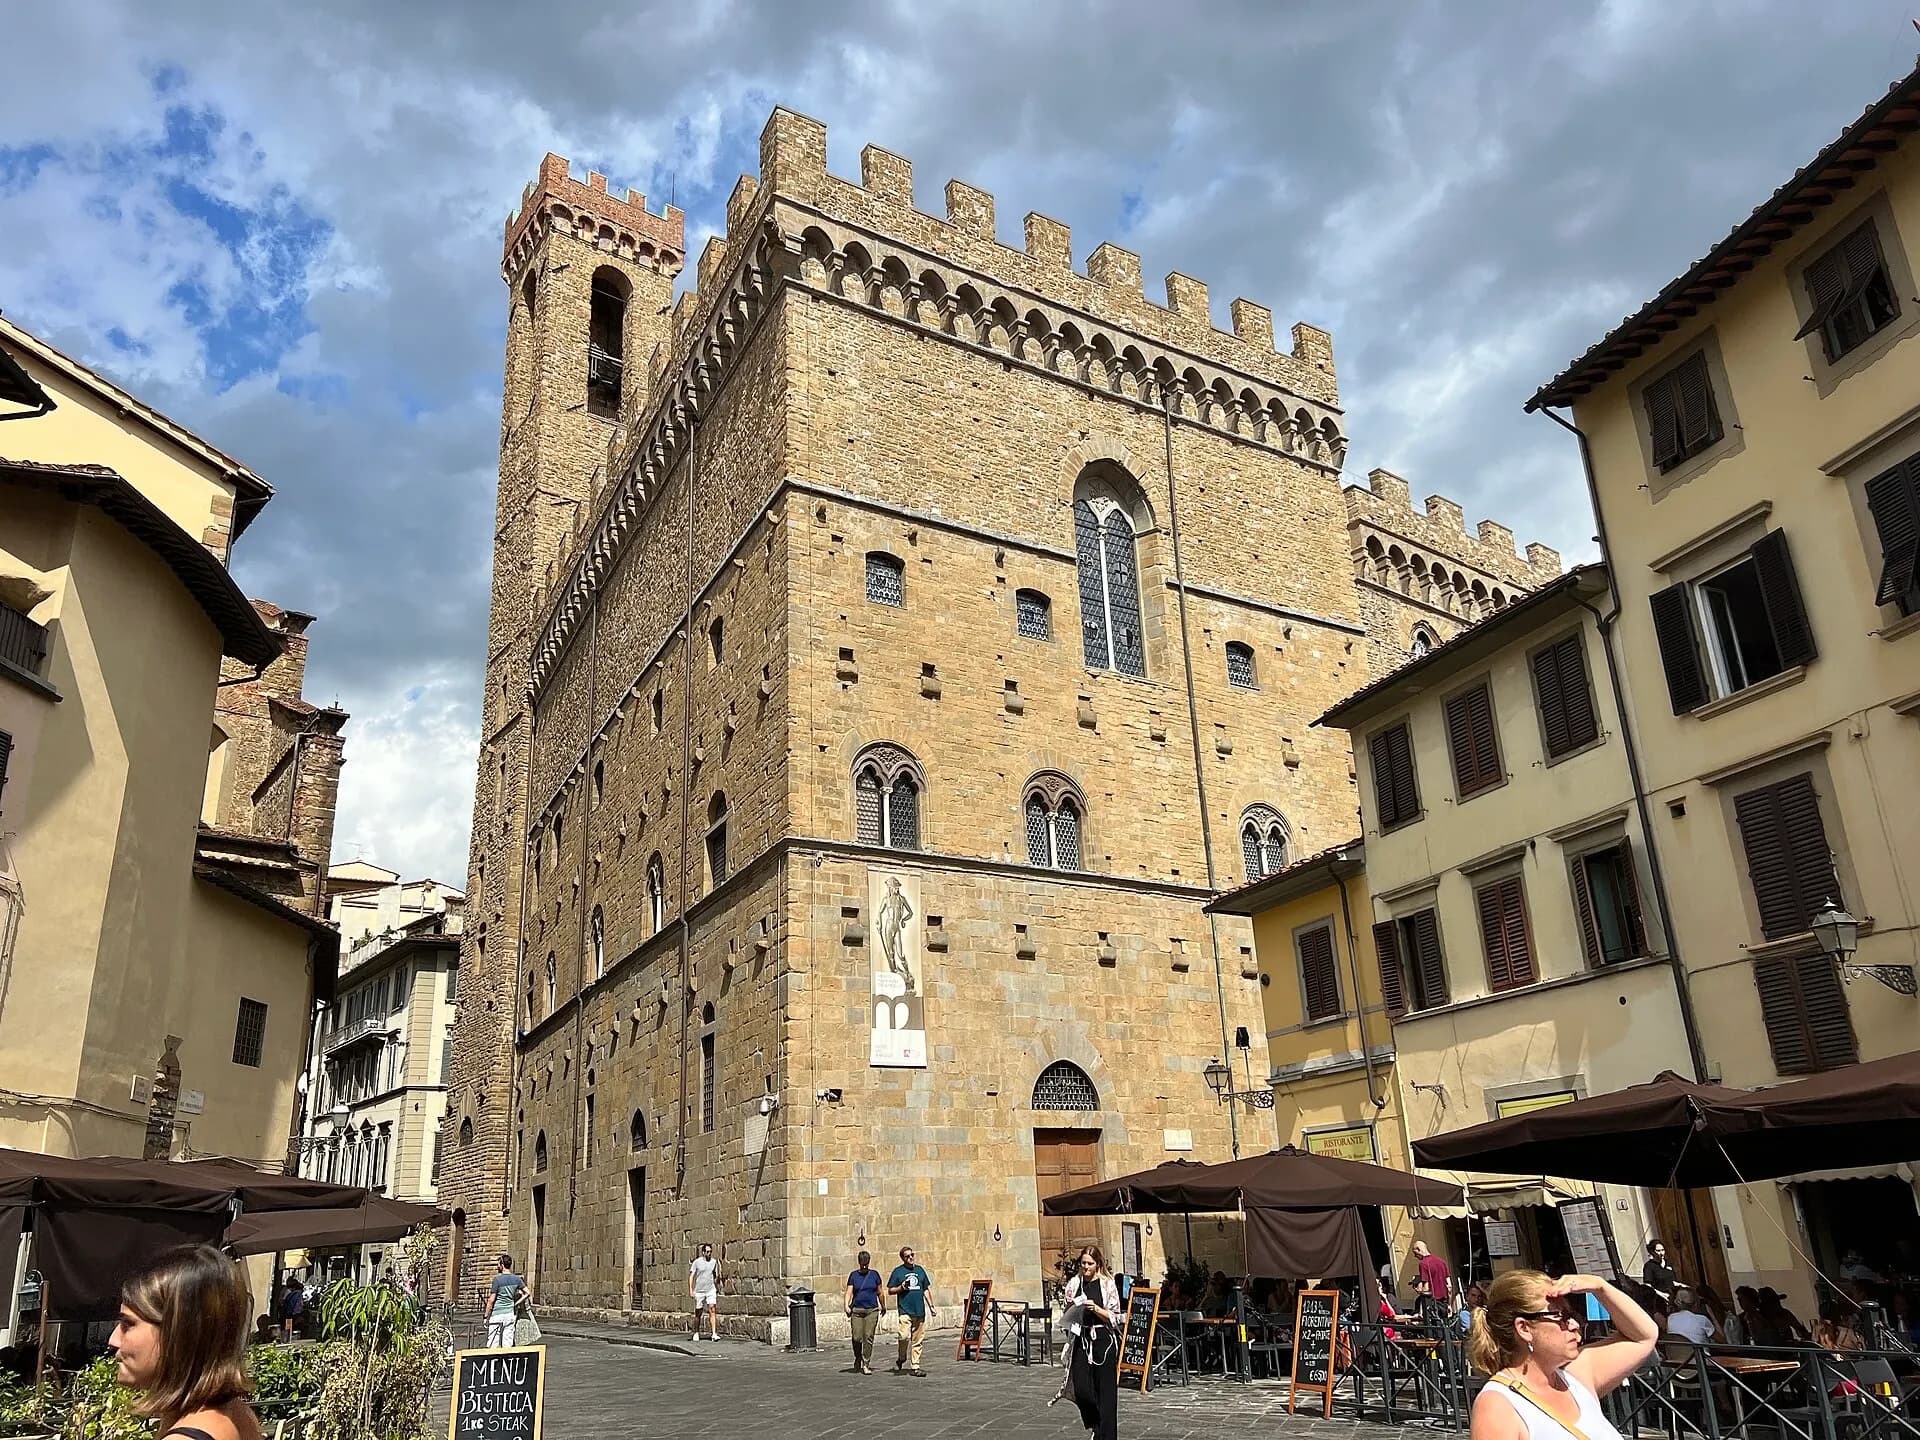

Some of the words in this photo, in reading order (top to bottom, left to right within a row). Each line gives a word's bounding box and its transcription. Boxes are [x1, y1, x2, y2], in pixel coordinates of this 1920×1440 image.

[1323, 1136, 1364, 1148] RISTORANTE
[468, 1357, 528, 1388] MENU
[459, 1390, 534, 1414] BISTECCA
[487, 1414, 529, 1431] STEAK
